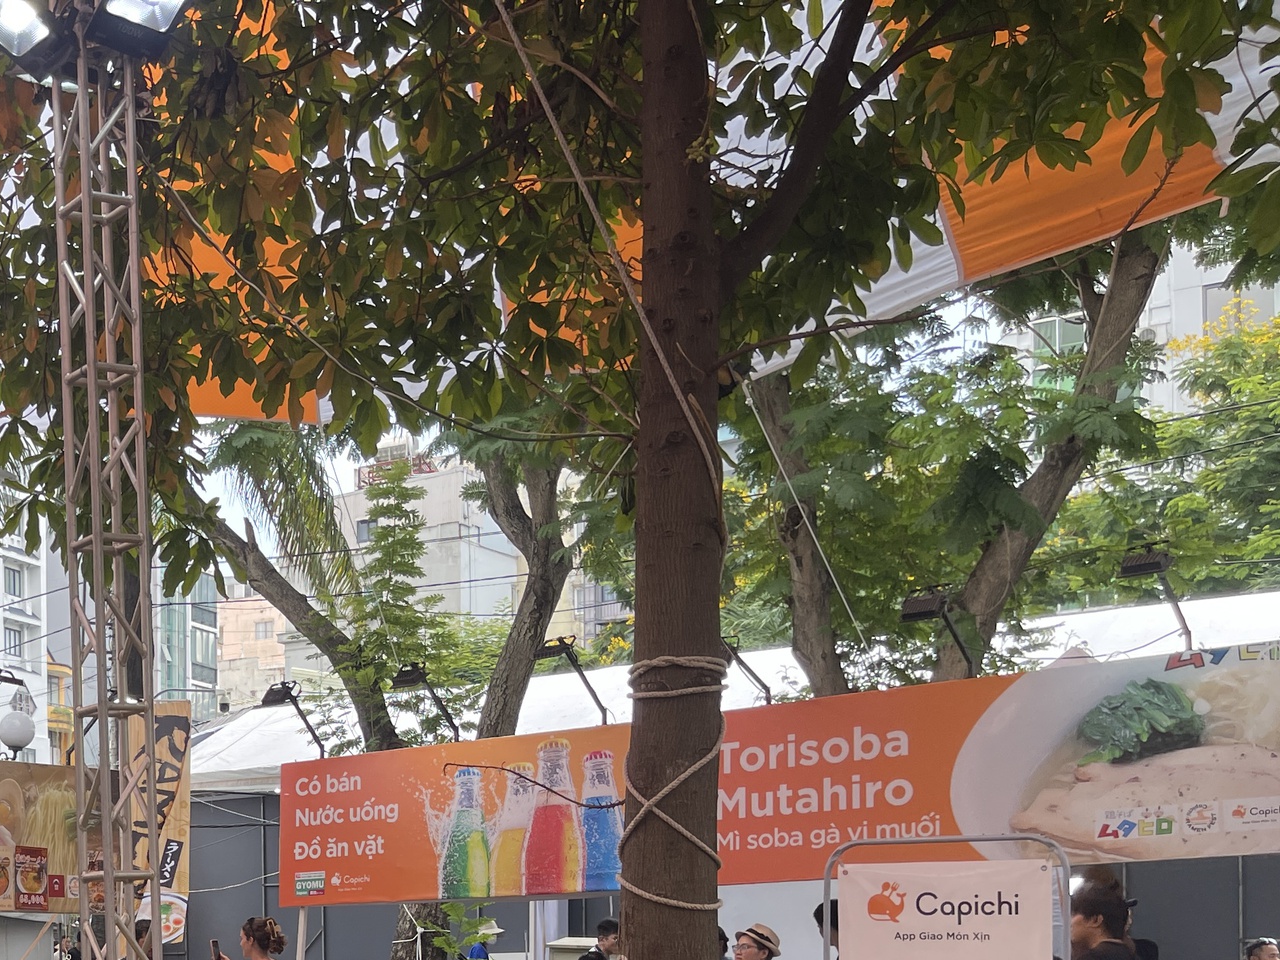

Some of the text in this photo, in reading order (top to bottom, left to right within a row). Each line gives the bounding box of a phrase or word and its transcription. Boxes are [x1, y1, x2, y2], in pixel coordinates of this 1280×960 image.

[720, 726, 910, 774] Torisoba
[295, 771, 361, 796] Có bán
[717, 774, 914, 821] Mutahiro
[295, 797, 399, 827] Nước uống
[717, 829, 740, 851] Mì
[746, 828, 803, 850] soba
[810, 823, 840, 849] gà
[876, 812, 942, 839] muối
[1097, 818, 1173, 839] ムタヒロ
[293, 834, 385, 860] Đồ ăn vặt
[296, 880, 325, 889] GYOMU
[343, 874, 370, 886] Capichi
[915, 891, 1019, 925] Capichi
[894, 931, 990, 942] App Giao Món Xịn
